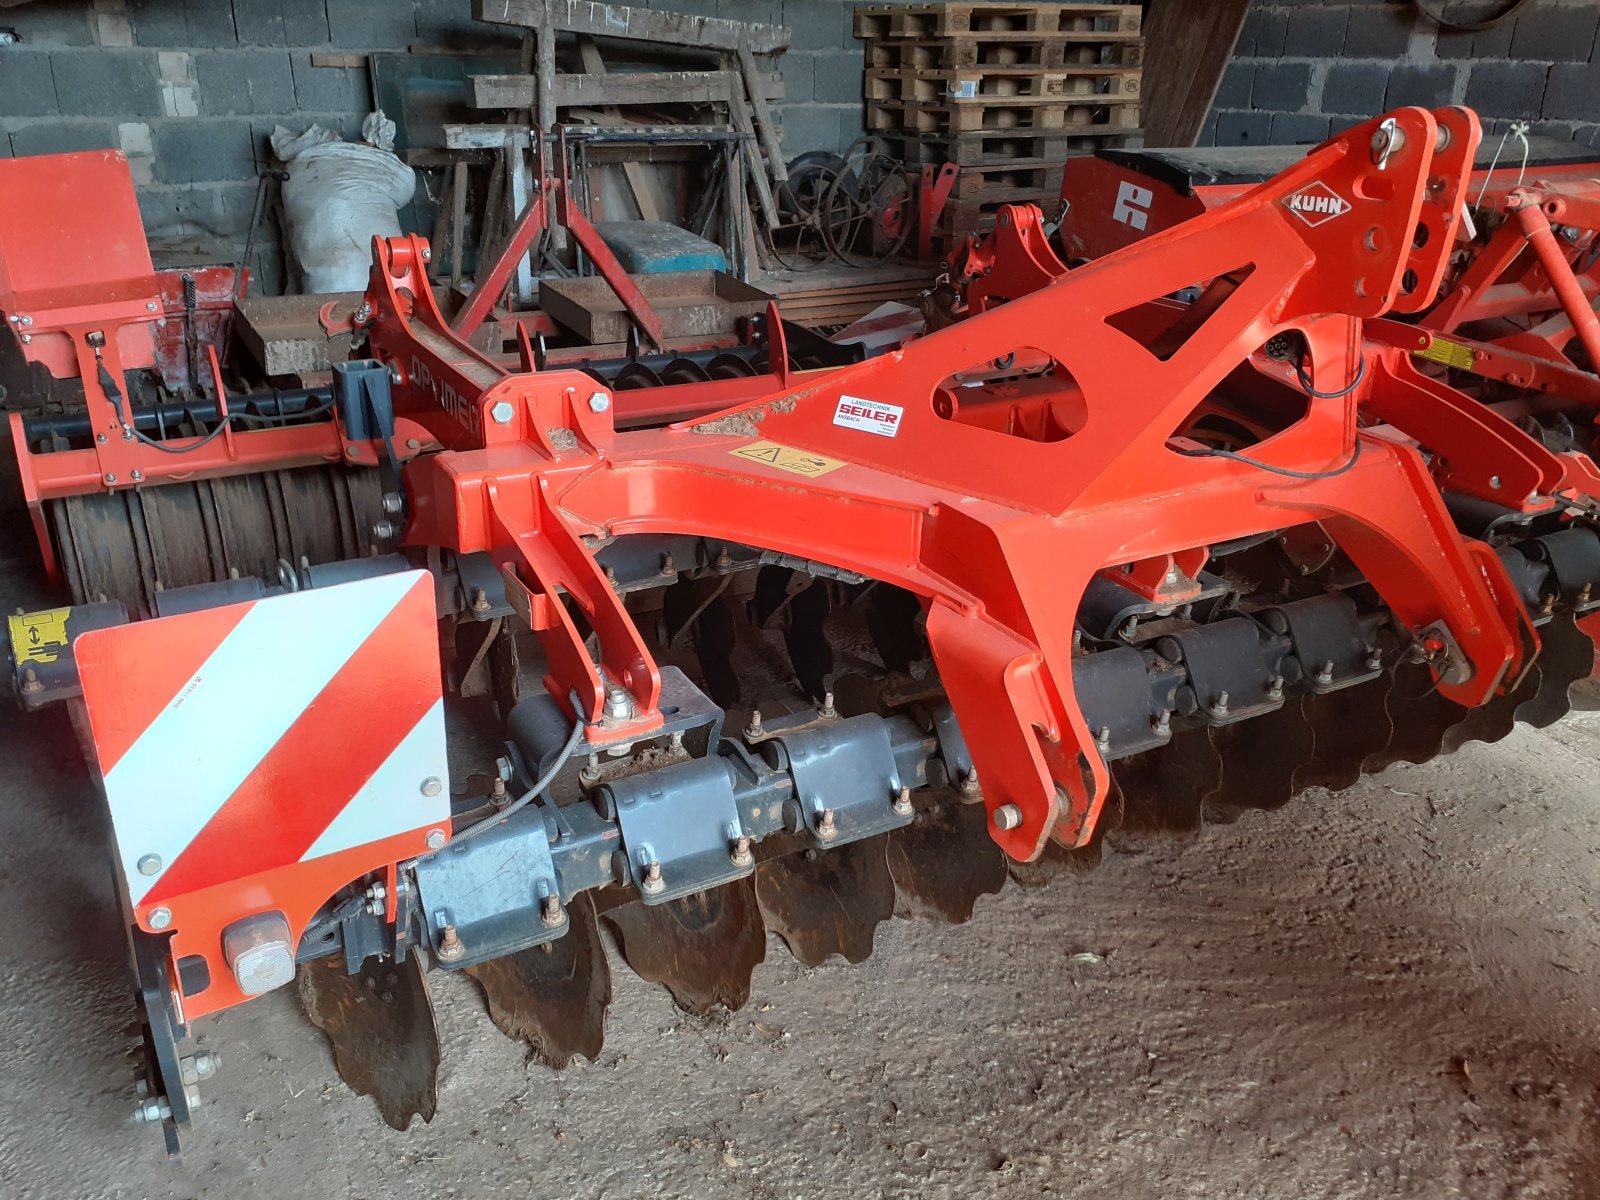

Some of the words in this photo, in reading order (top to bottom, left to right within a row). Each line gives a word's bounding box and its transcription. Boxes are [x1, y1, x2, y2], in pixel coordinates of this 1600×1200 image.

[1290, 195, 1342, 214] KUHN
[839, 404, 898, 424] SEILER
[851, 400, 891, 411] LANDTECHNIK
